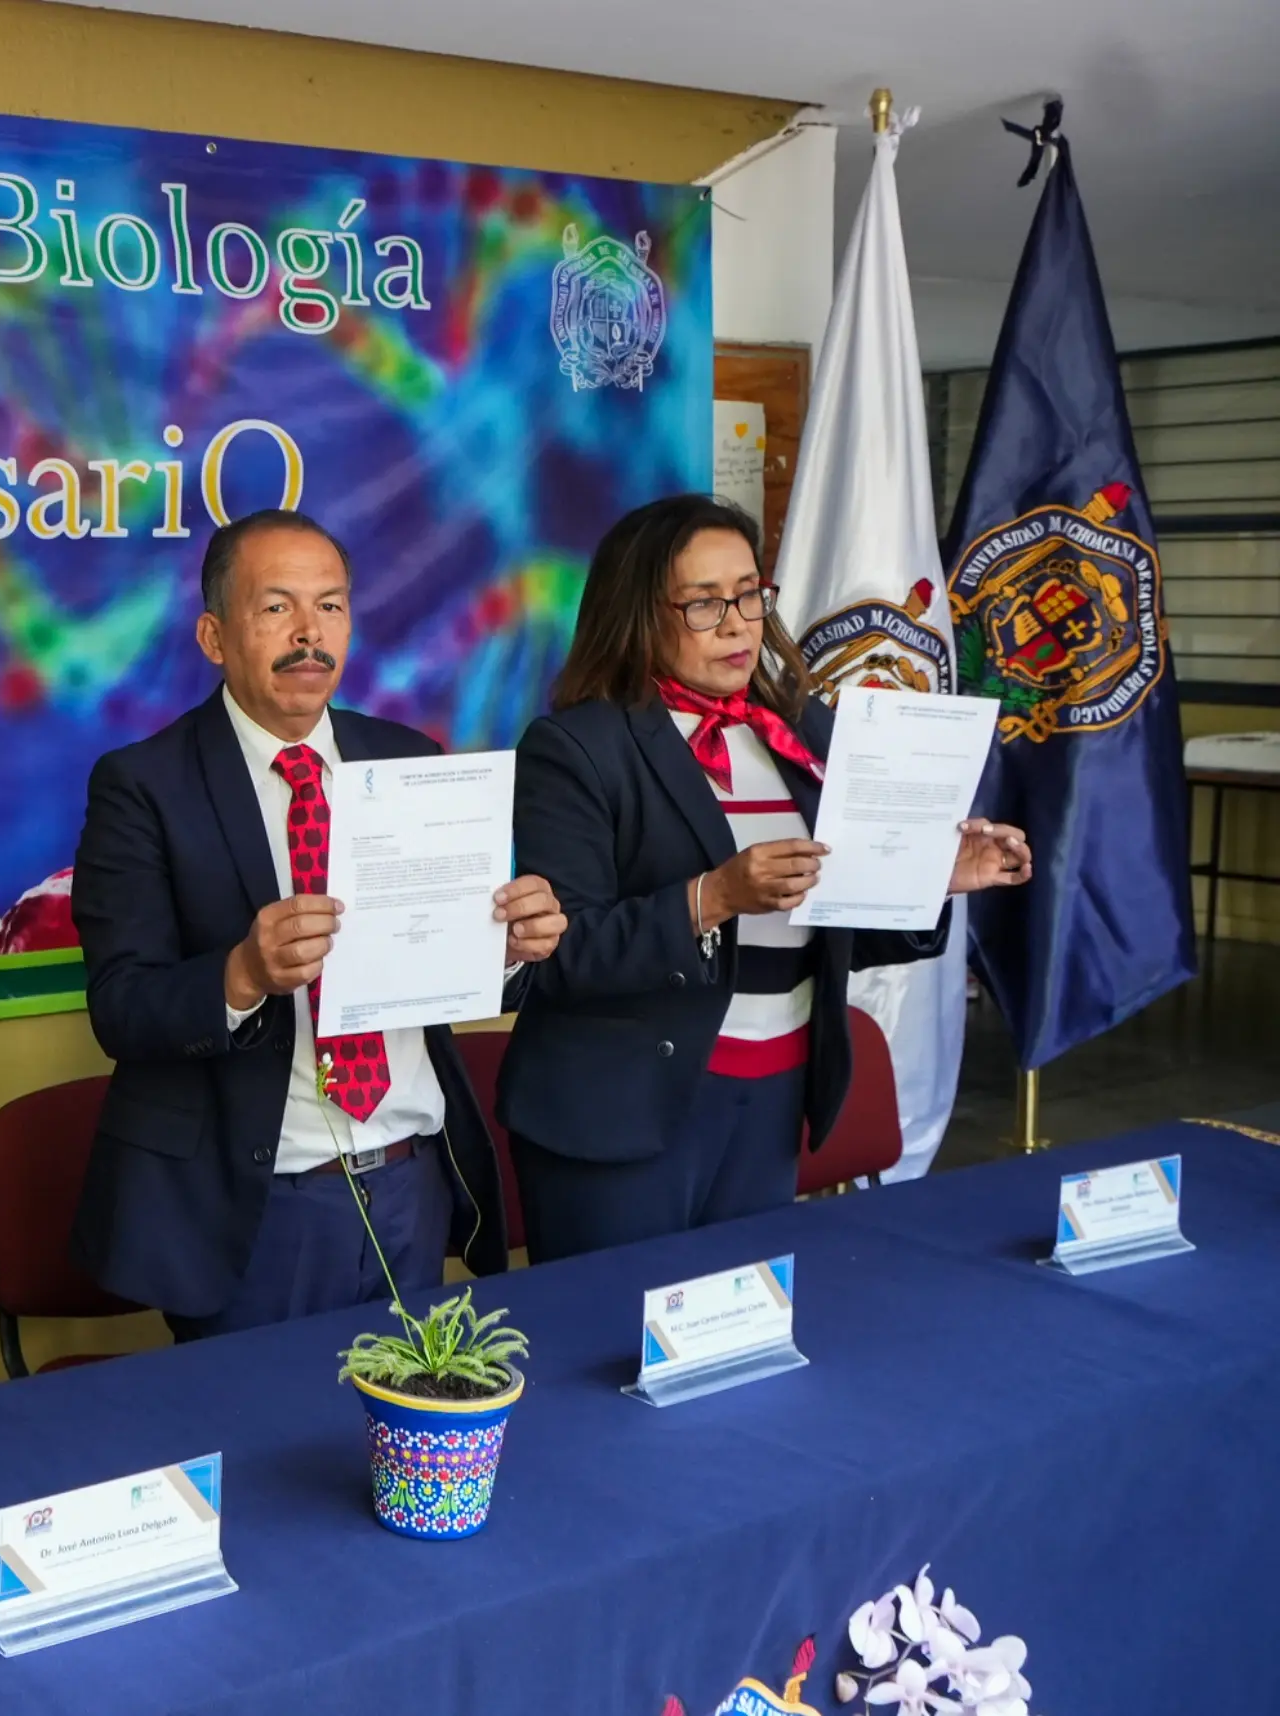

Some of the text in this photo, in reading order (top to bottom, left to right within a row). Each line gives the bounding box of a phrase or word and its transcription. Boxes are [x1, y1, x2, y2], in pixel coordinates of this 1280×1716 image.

[960, 521, 1045, 588] UNIVERSIDAD
[1048, 515, 1137, 561] MICHOACANA
[1136, 557, 1150, 581] DE
[1137, 582, 1148, 611] SAN
[870, 609, 942, 658] MICHOACANA
[1069, 682, 1134, 725] HIDALGO
[57, 1542, 78, 1555] José
[78, 1532, 117, 1549] Antonio
[118, 1526, 140, 1539] Luna
[141, 1515, 179, 1533] Delgado
